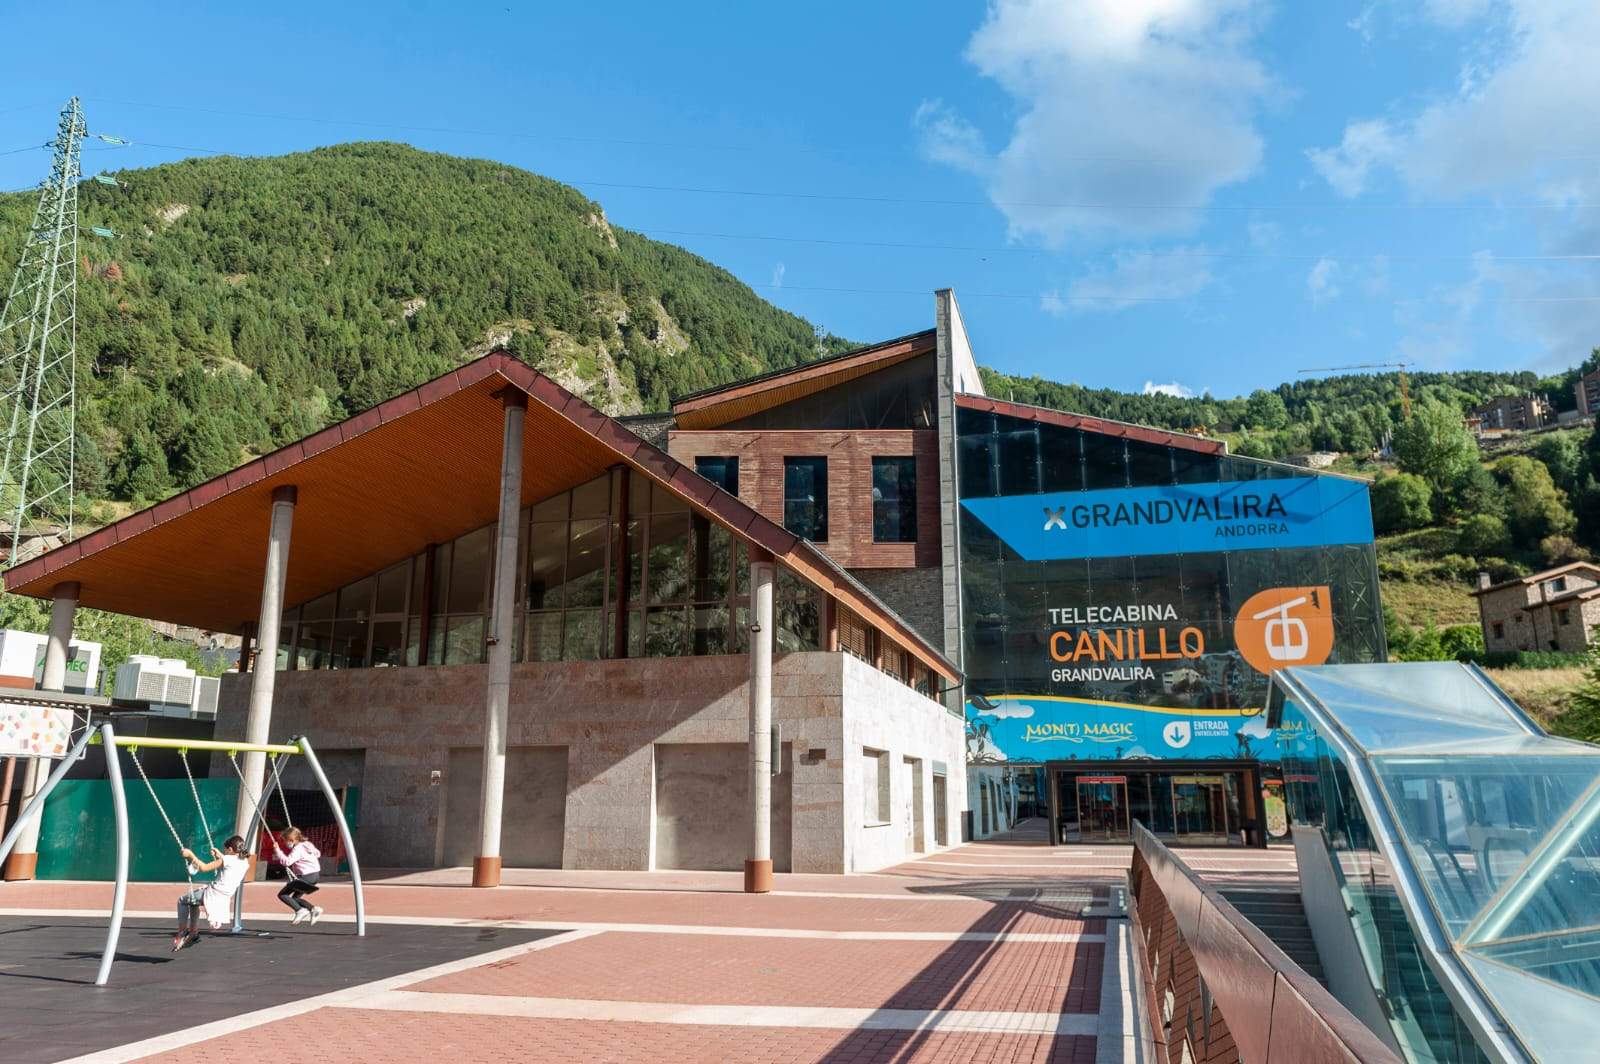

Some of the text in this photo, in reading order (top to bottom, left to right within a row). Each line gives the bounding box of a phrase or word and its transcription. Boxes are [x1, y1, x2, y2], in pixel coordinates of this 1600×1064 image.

[1072, 493, 1288, 529] GRANDVALIRA
[1214, 522, 1289, 537] ANDORRA
[1048, 604, 1178, 624] TELECABINA
[1050, 626, 1205, 662] CANILLO
[1051, 667, 1155, 682] GRANDVALIRA
[1083, 722, 1134, 735] MAGIC
[1193, 720, 1229, 730] ENTRADA
